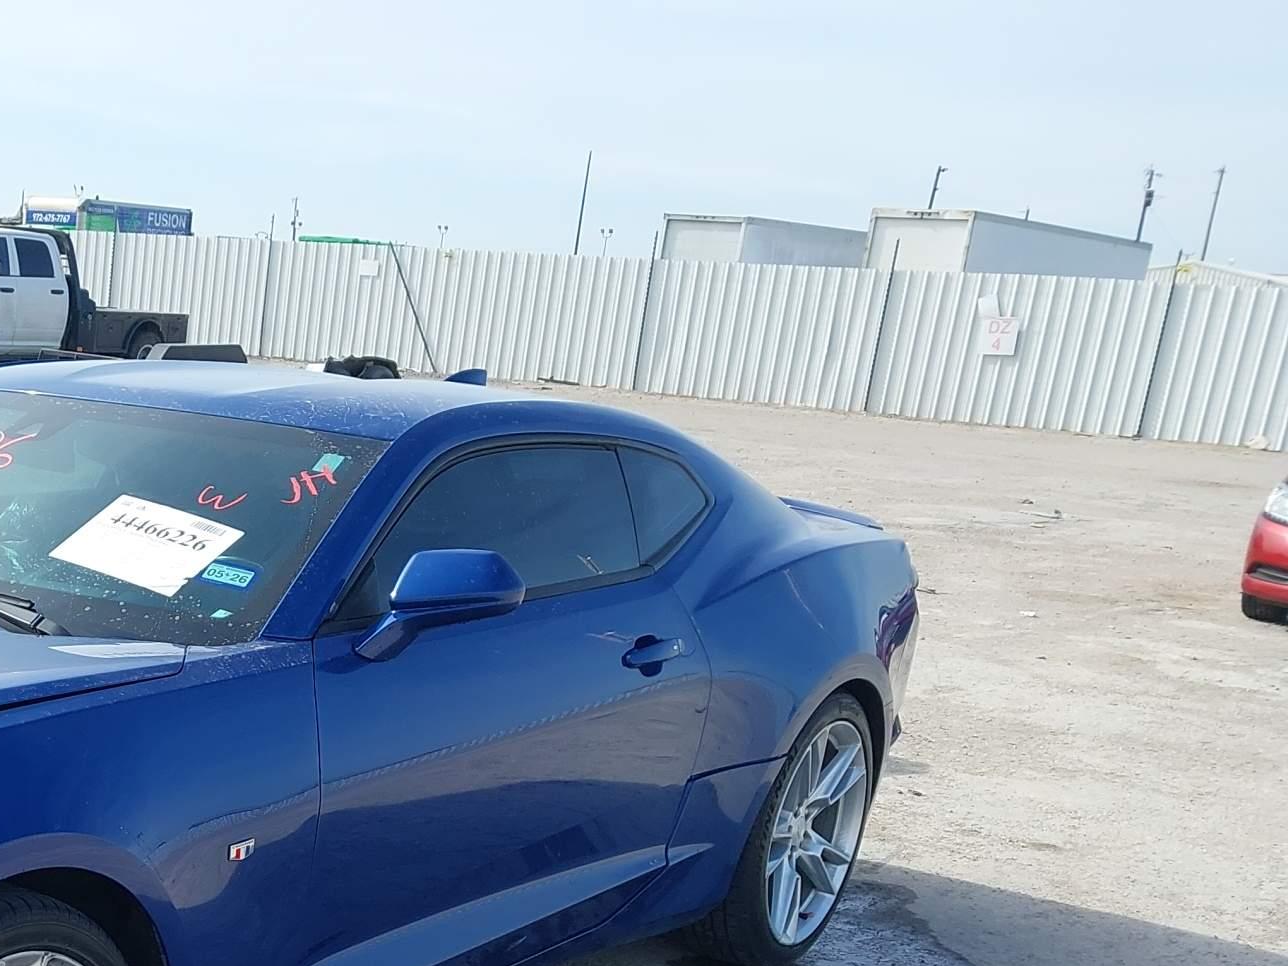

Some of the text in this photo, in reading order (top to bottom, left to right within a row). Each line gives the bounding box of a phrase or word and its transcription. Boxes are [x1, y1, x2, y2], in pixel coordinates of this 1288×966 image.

[32, 213, 71, 223] 972-675-7767
[147, 211, 187, 228] FUSION
[988, 320, 1012, 334] DZ
[992, 335, 1001, 352] 4
[110, 512, 214, 552] 44466226
